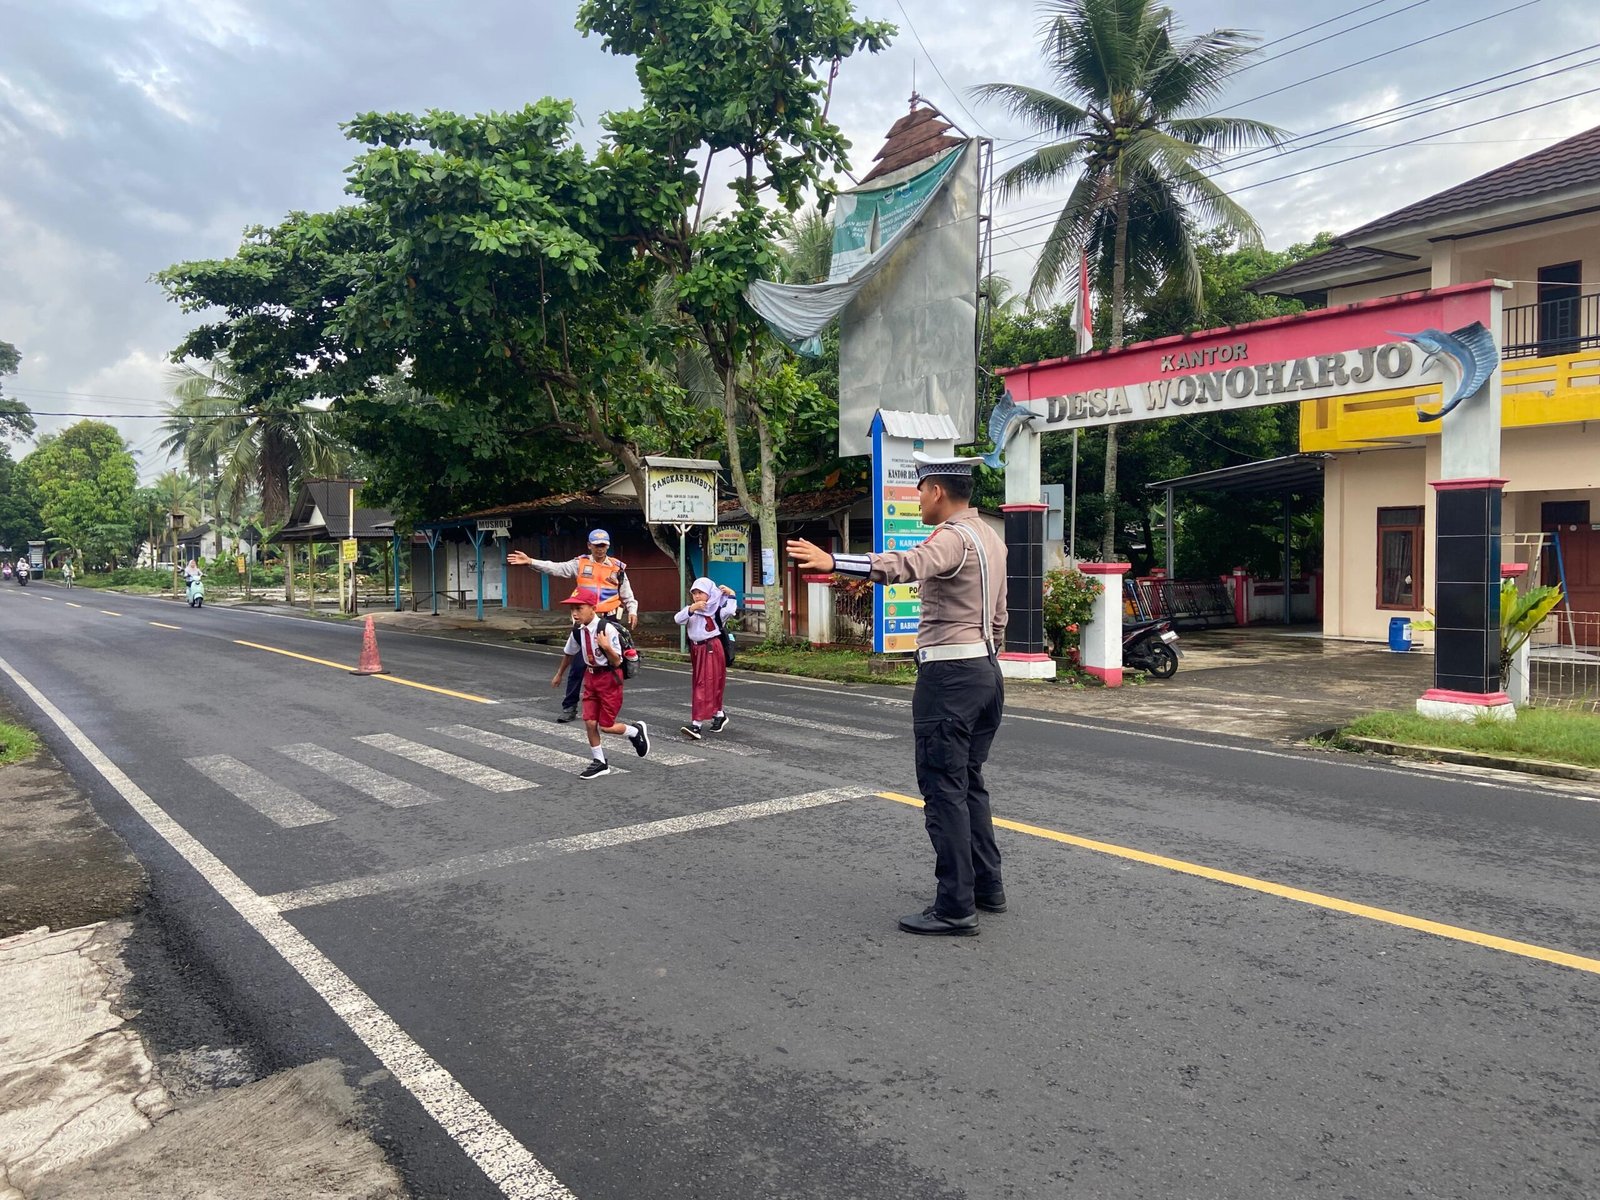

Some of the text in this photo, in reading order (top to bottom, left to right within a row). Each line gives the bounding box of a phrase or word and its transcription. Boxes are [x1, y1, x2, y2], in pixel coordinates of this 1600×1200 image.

[1160, 342, 1248, 373] KANTOR
[1046, 342, 1413, 424] DESA WONOHARJO
[651, 474, 713, 493] PANGKAS RAMBUT
[888, 469, 918, 480] KANTOR DES
